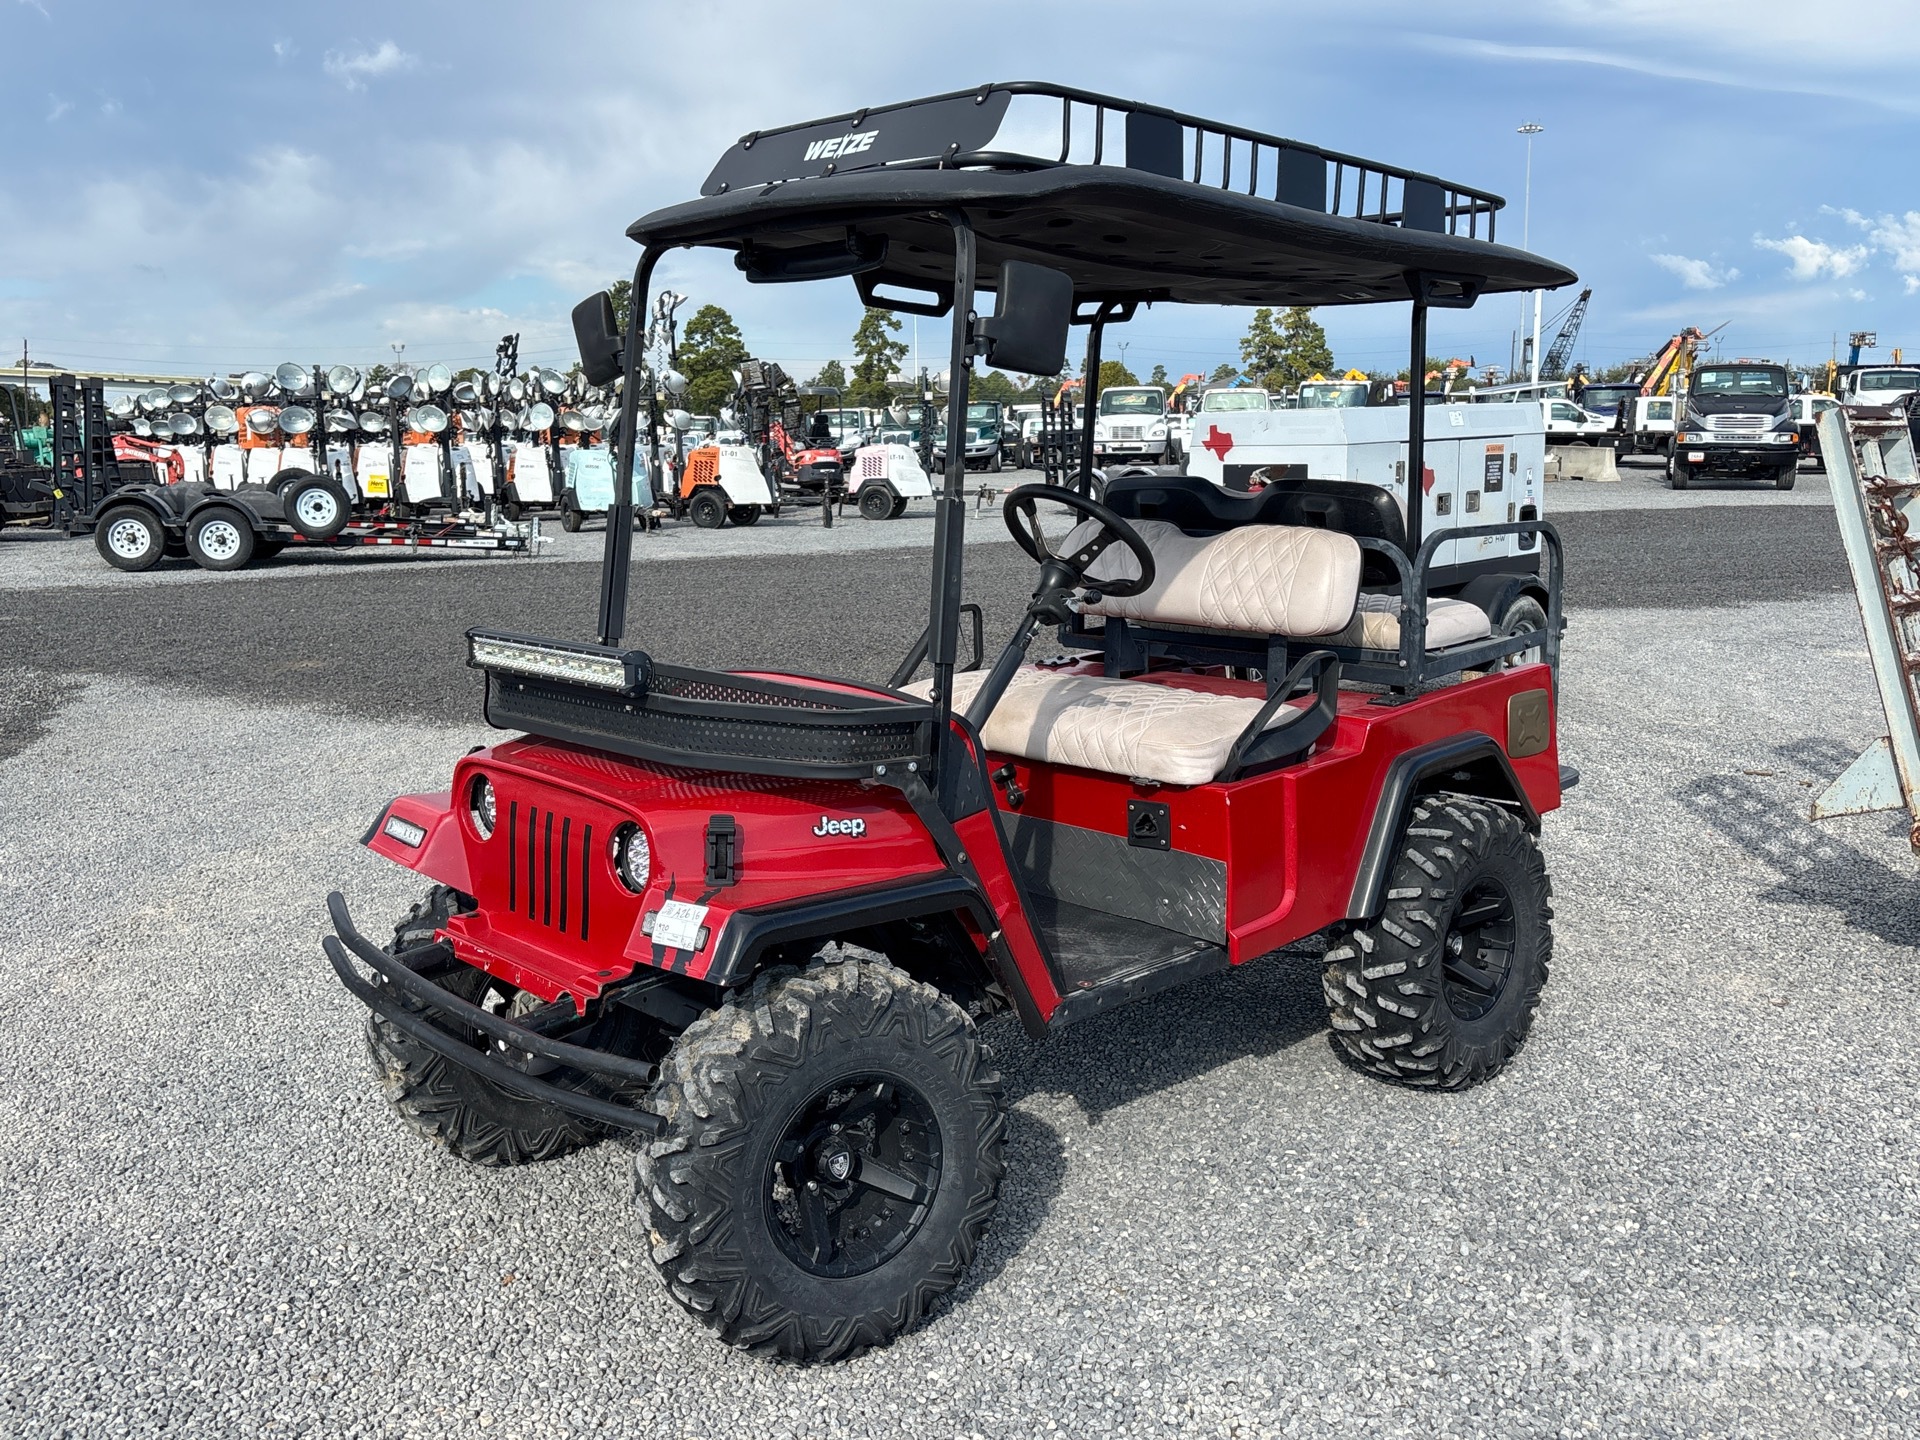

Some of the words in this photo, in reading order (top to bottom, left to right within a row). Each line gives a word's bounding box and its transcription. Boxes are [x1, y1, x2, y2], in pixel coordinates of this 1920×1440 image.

[804, 130, 879, 161] WEIZE
[1483, 536, 1494, 545] 20
[813, 815, 866, 837] Jeep
